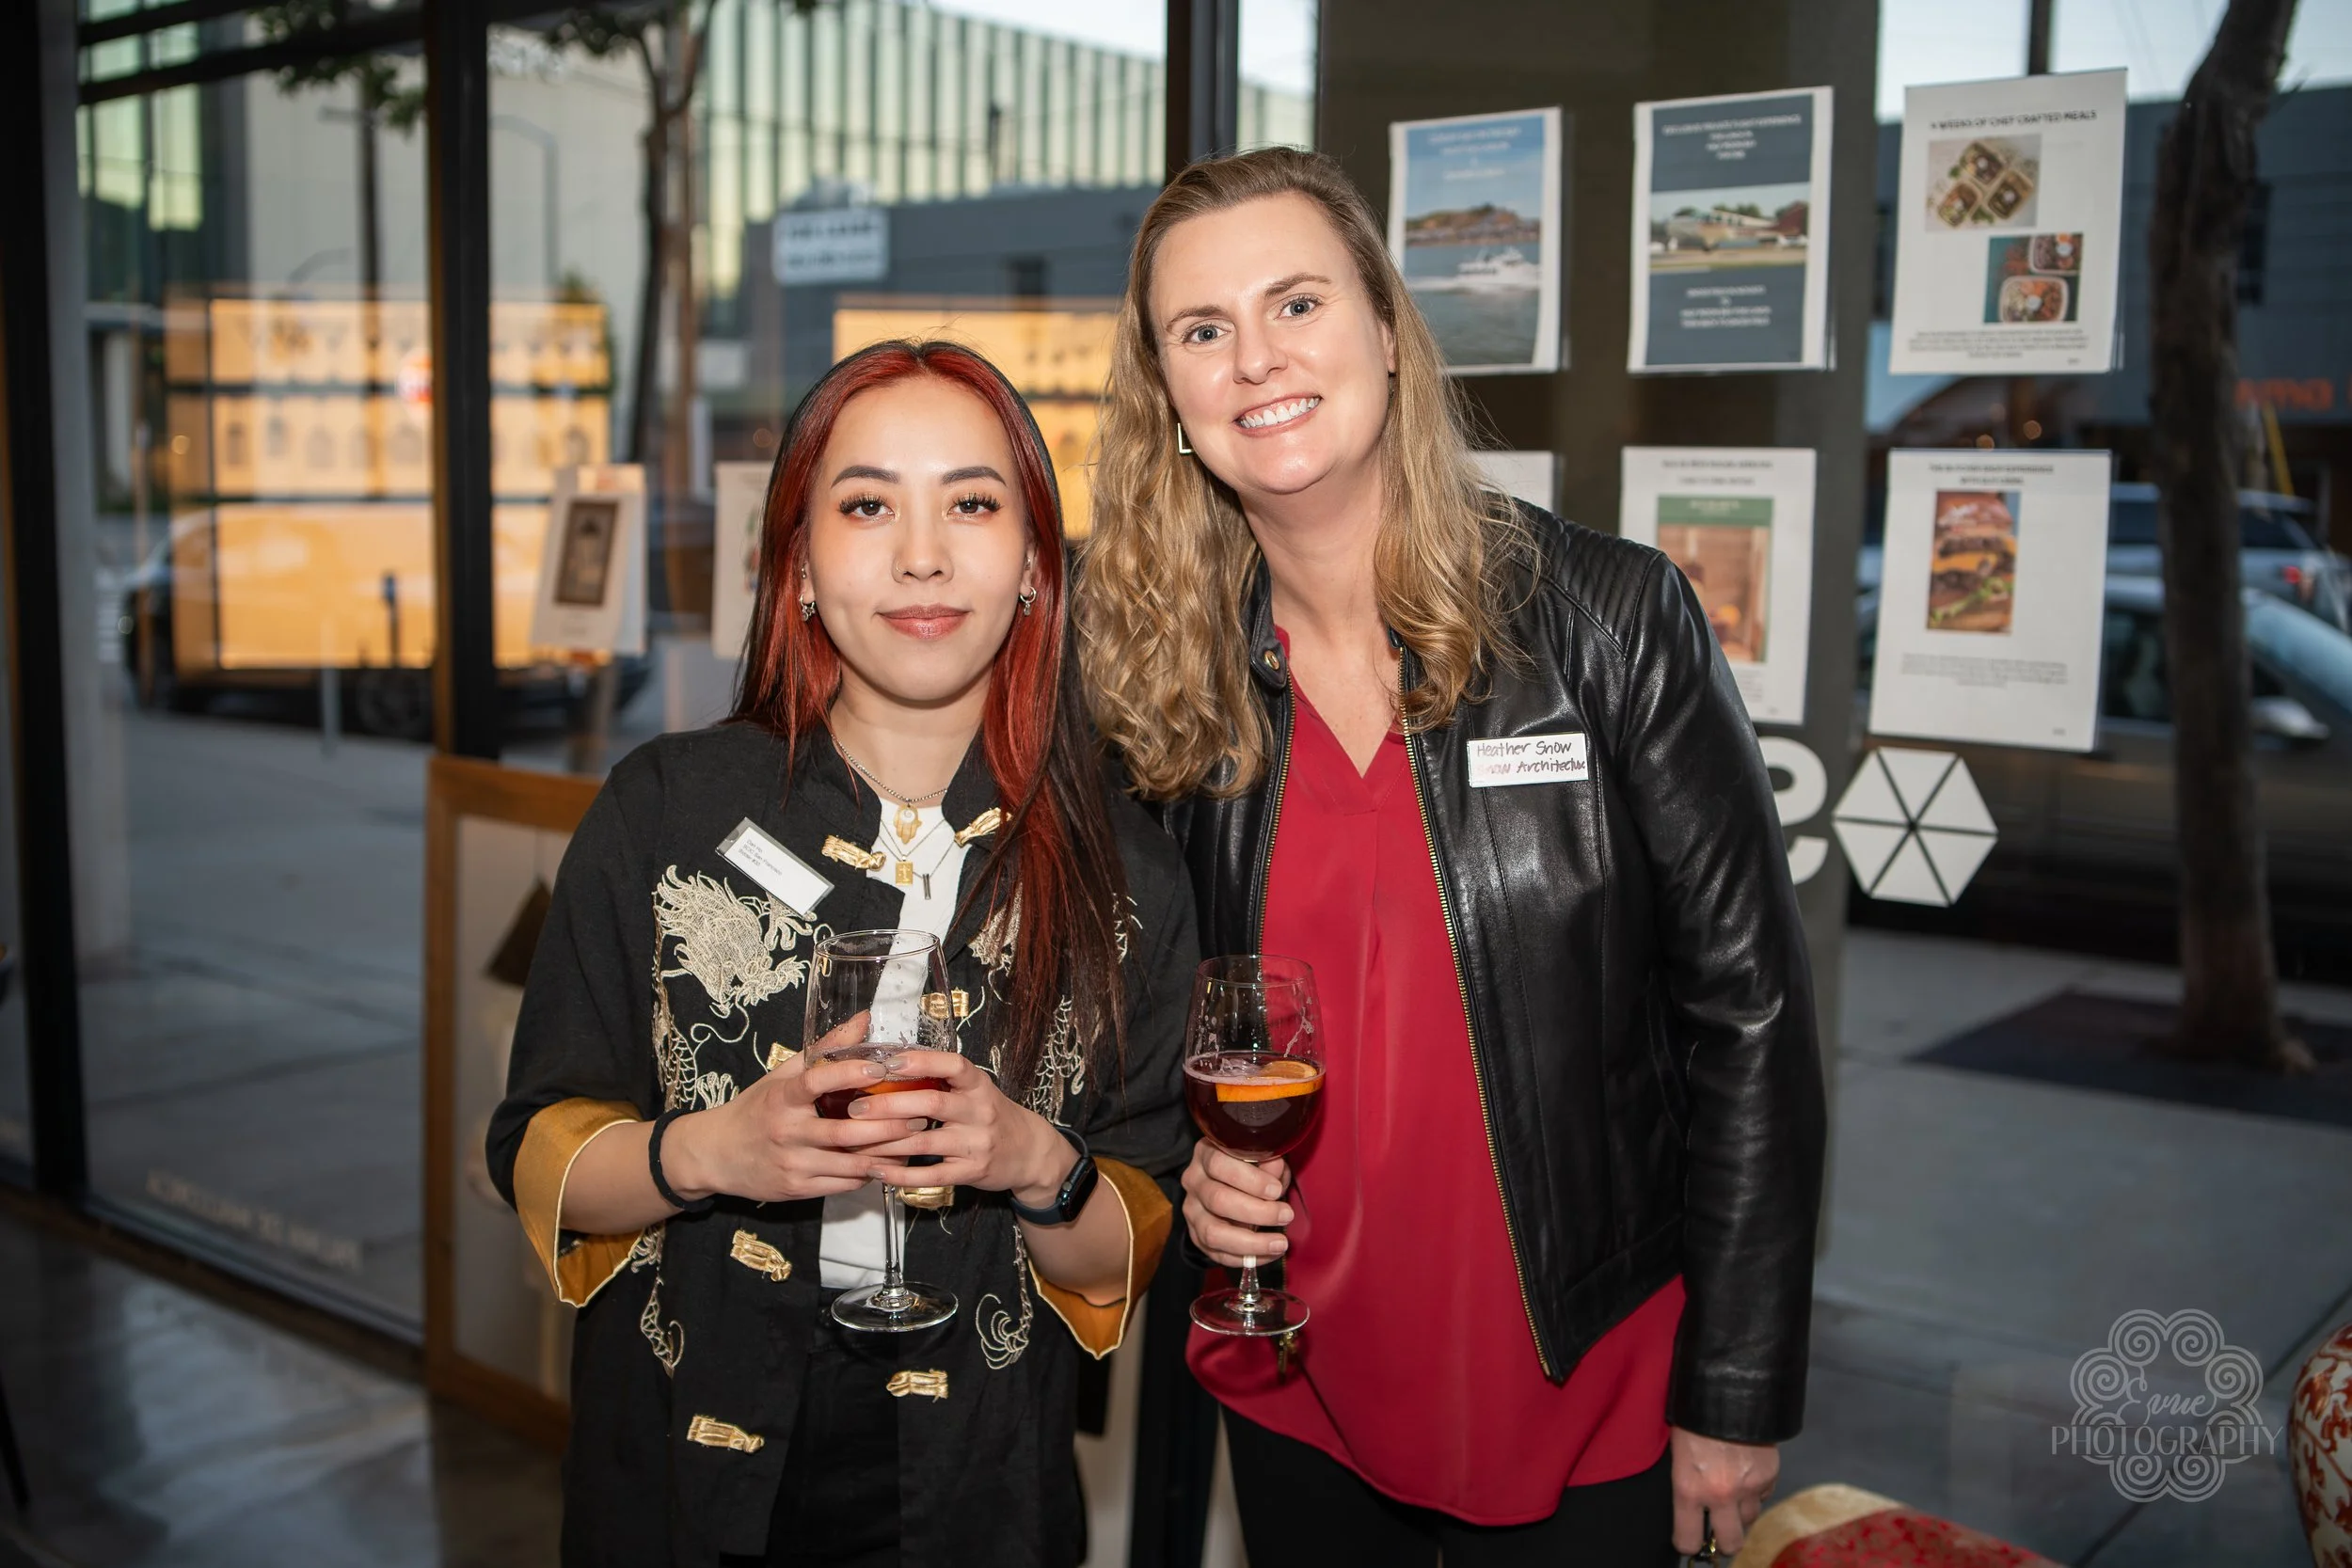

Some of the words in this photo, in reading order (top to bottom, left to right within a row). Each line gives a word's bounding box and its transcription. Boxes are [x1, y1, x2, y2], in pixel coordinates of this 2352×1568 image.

[1975, 117, 1987, 127] OF
[1990, 116, 2014, 127] CHEF
[2017, 112, 2063, 125] CRAFTED
[2063, 108, 2098, 121] MEALS
[1476, 742, 1532, 757] Heather
[1535, 740, 1572, 755] Snow
